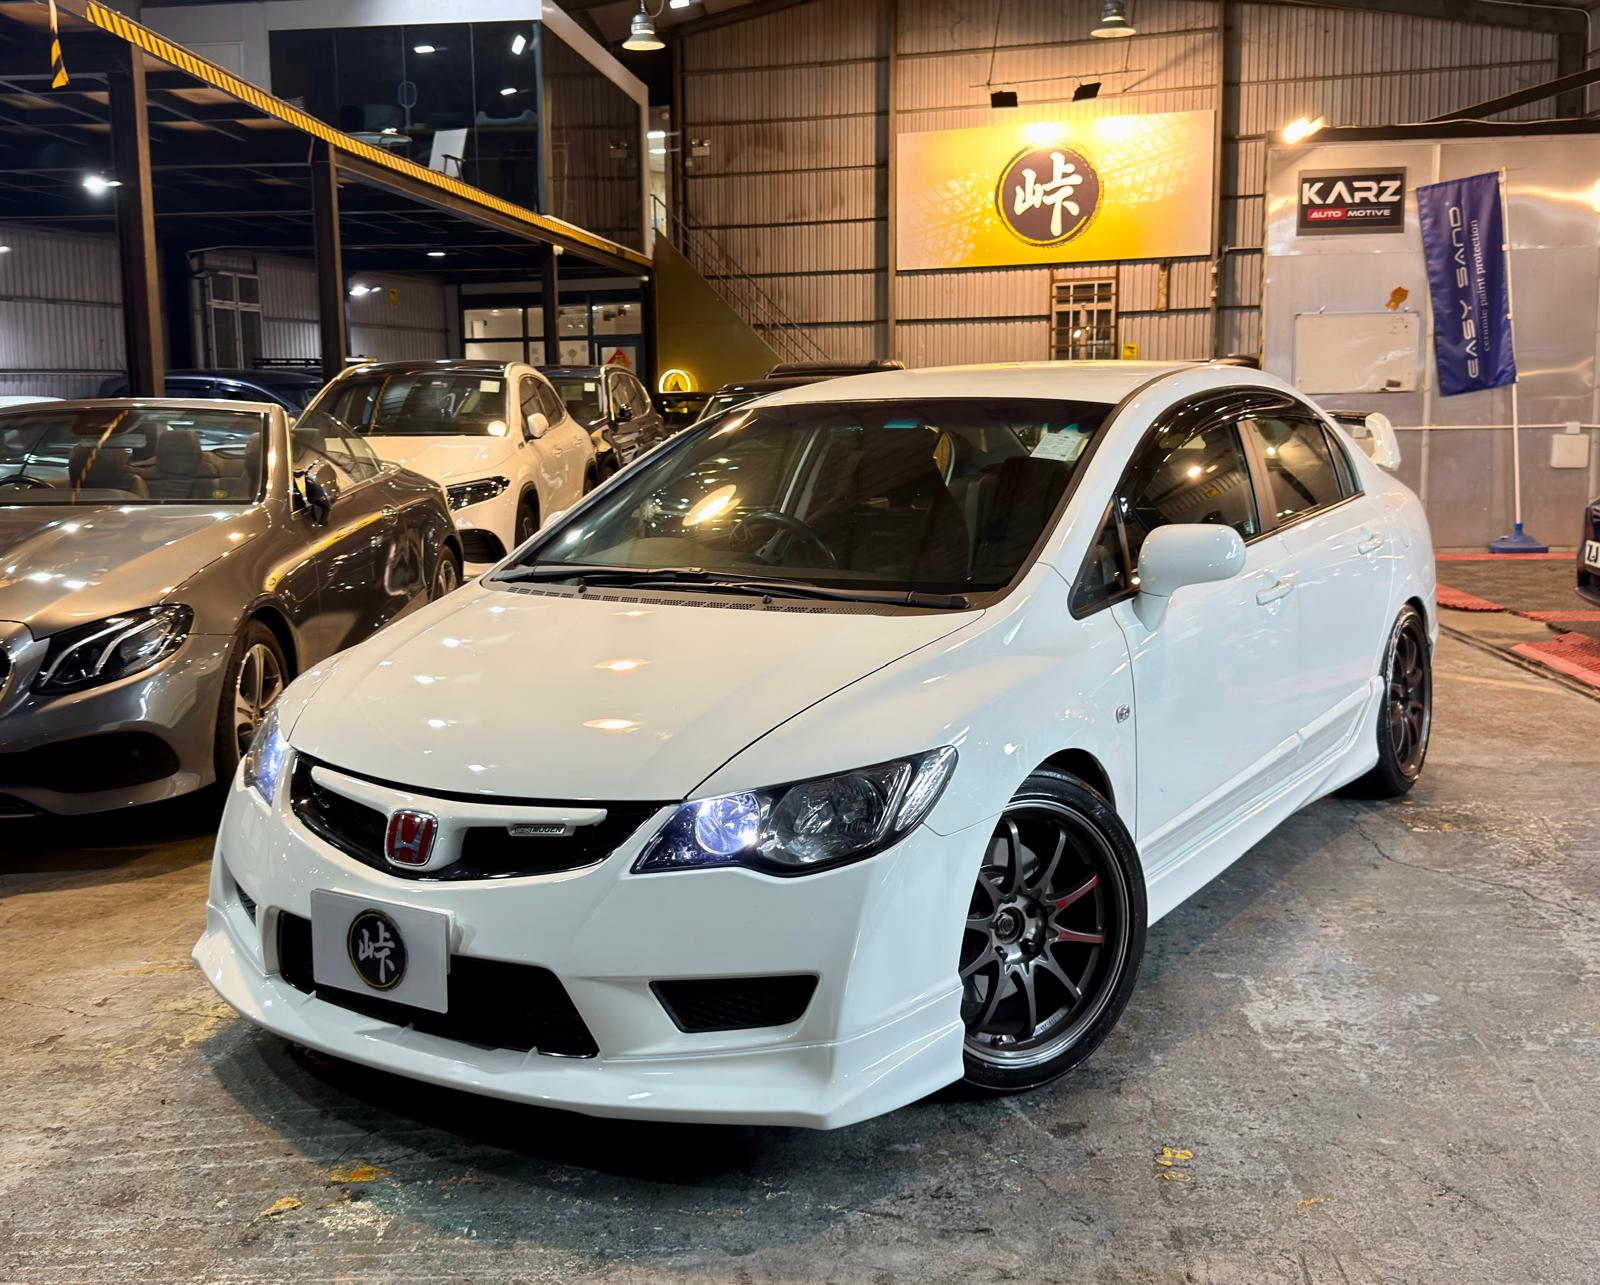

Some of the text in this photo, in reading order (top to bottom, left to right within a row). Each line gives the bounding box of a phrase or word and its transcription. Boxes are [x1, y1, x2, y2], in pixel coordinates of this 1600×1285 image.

[1014, 151, 1084, 237] 峠
[1302, 180, 1401, 205] KARZ
[1310, 208, 1392, 218] AUTO MOTIVE
[1469, 219, 1486, 275] protection
[1448, 206, 1480, 379] EASY SAND
[1476, 277, 1489, 306] paint
[358, 921, 396, 984] 峠
